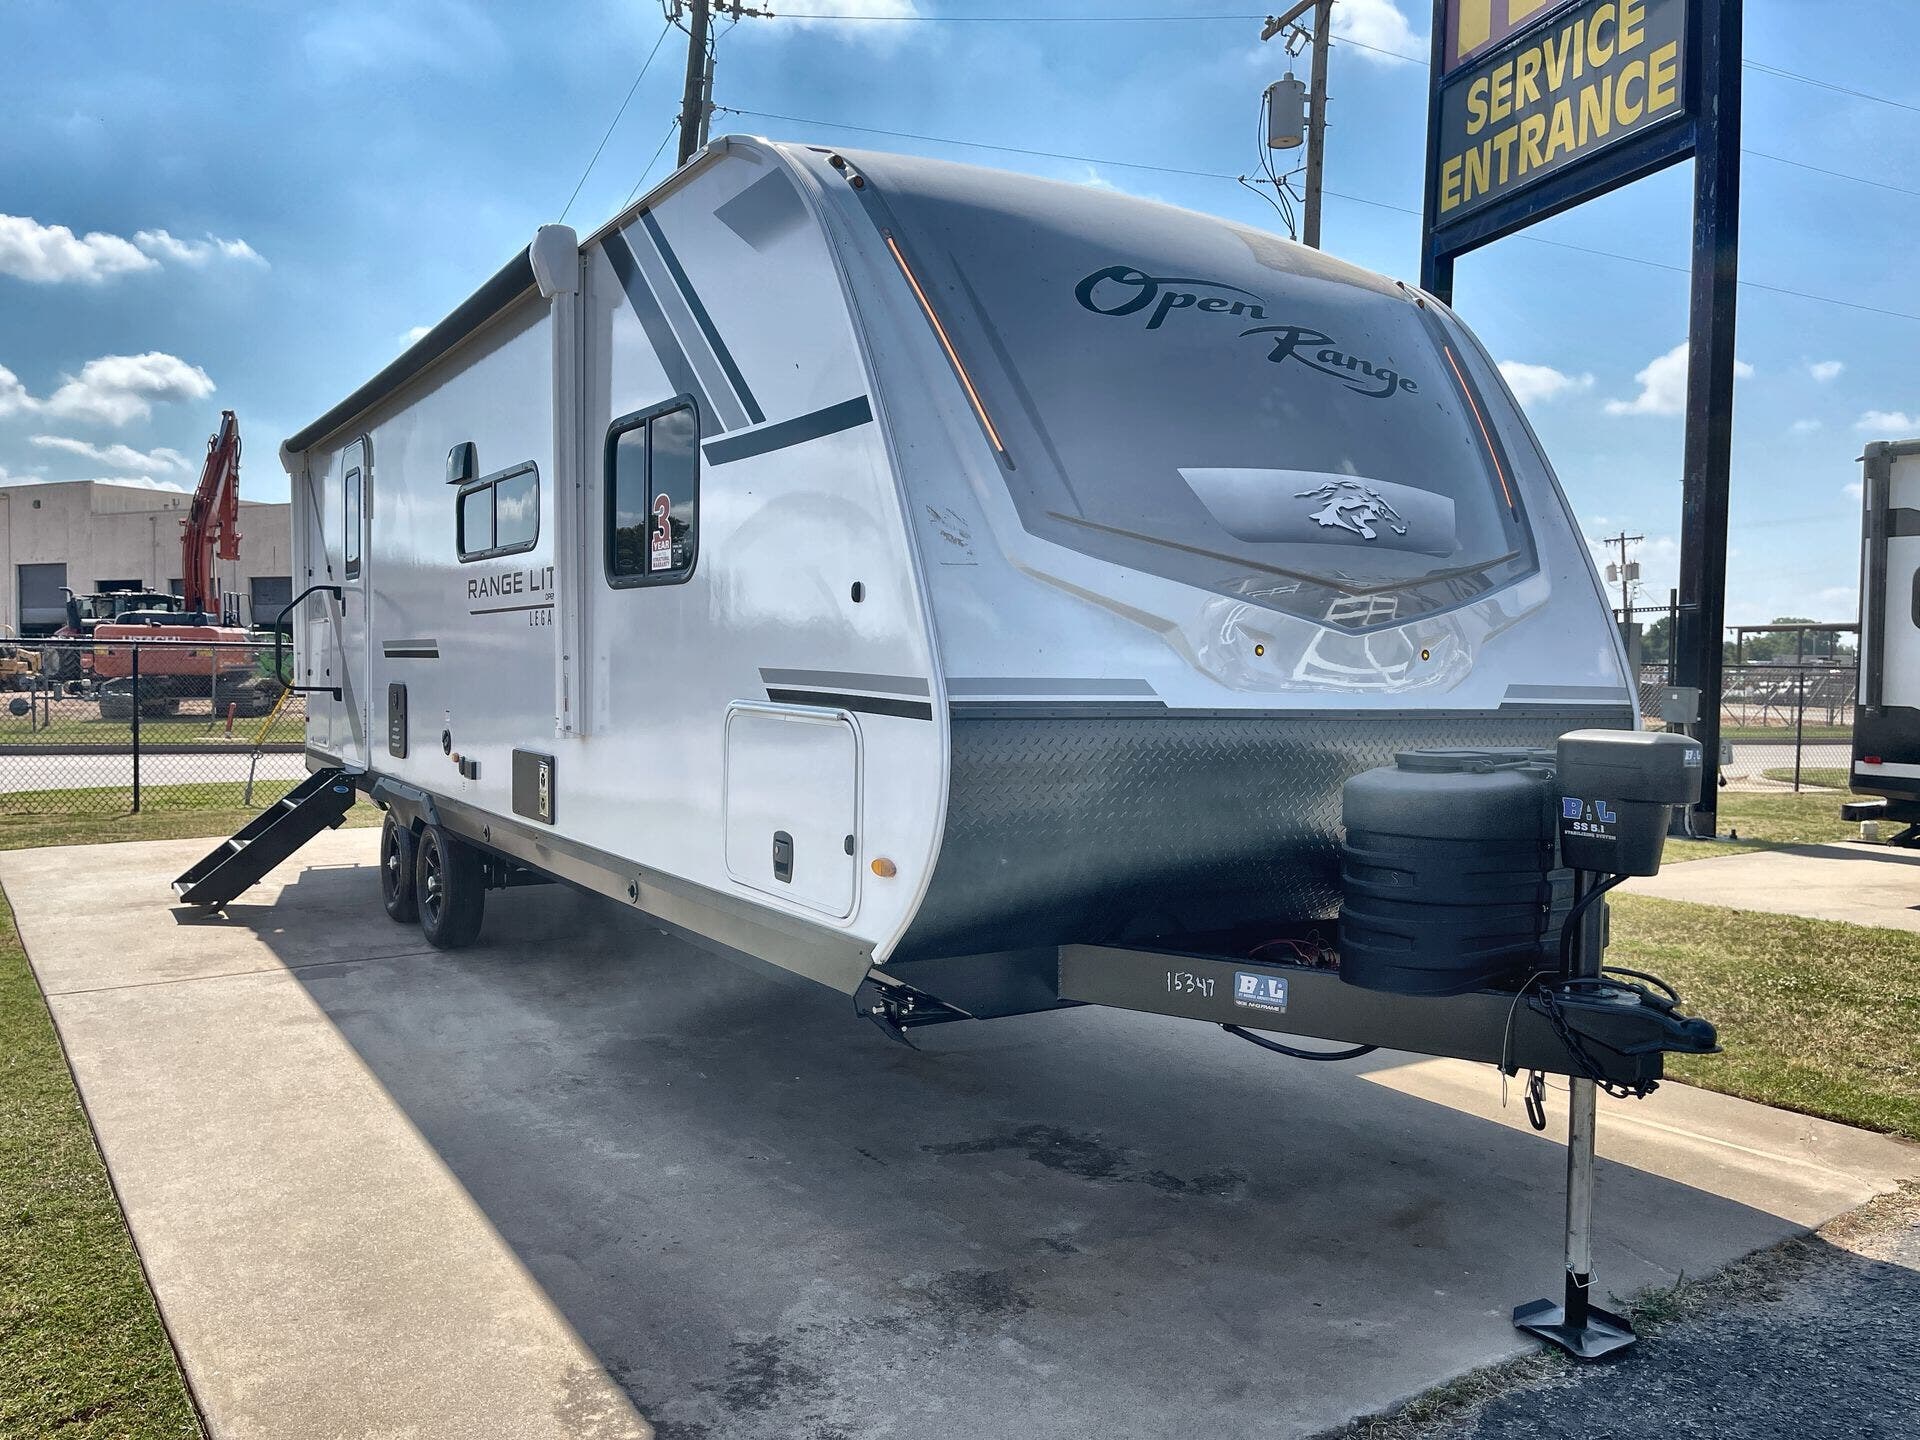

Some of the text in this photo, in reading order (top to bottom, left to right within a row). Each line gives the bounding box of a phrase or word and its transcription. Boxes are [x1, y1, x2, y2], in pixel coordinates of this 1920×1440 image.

[1466, 0, 1645, 136] SERVICE
[1440, 41, 1677, 214] ENTRANCE
[1074, 265, 1270, 330] Open
[1239, 325, 1420, 399] Range
[653, 493, 671, 541] 3
[653, 540, 670, 552] YEAR
[467, 571, 523, 599] RANGE
[529, 609, 553, 626] LEGA
[1573, 821, 1605, 834] SS 5.1
[1166, 971, 1215, 998] 15347
